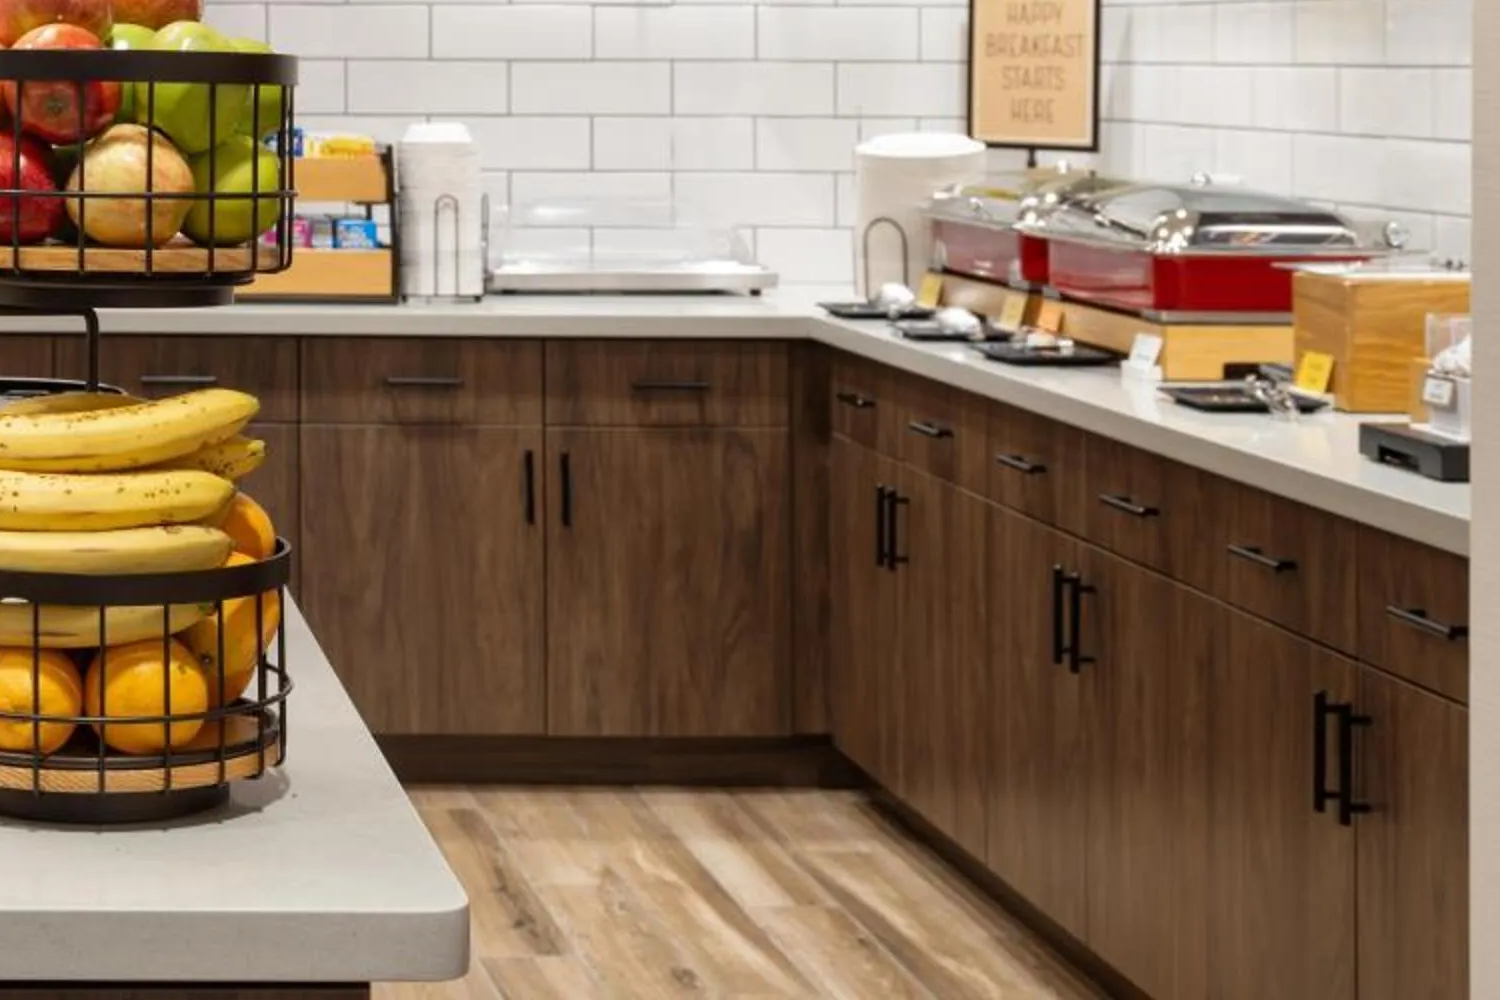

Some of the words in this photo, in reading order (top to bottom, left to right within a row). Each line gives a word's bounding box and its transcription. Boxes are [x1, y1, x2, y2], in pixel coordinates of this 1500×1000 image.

[1006, 1, 1064, 24] HAPPY
[985, 33, 1086, 58] BREAKFAST
[1001, 66, 1066, 90] STARTS
[1011, 98, 1055, 123] HERE
